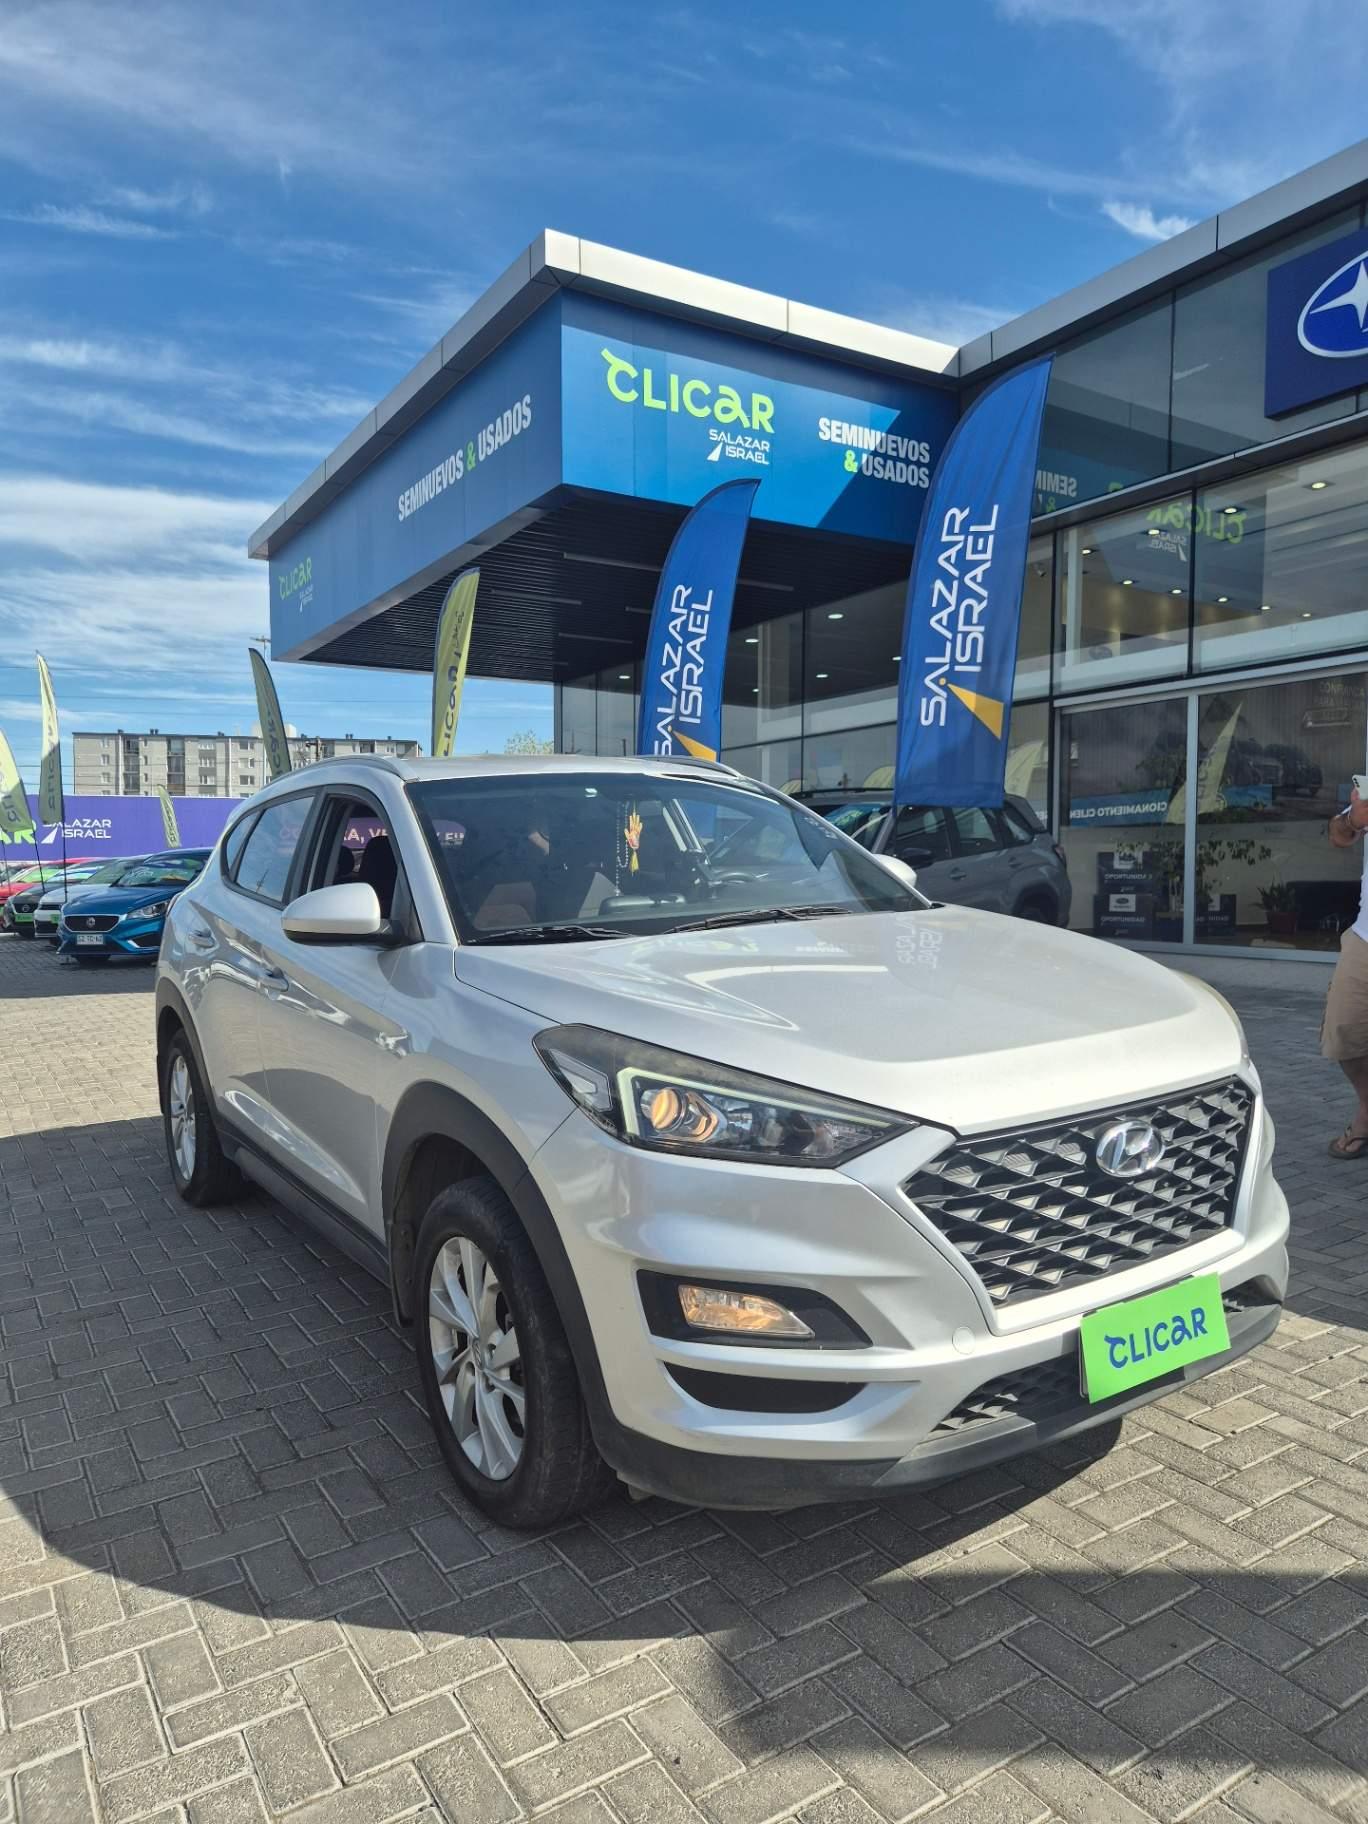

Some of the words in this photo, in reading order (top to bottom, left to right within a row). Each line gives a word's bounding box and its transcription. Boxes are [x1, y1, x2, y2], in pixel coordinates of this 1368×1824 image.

[398, 449, 465, 523] SEMINUEVOS
[466, 441, 477, 472] &
[477, 394, 532, 462] USADOS
[708, 428, 771, 453] SALAZAR
[725, 445, 770, 465] ISRAEL
[818, 417, 930, 464] SEMINUEVOS
[843, 449, 859, 473] &
[861, 453, 930, 489] USADOS
[920, 506, 970, 727] SALAZAR
[954, 504, 999, 673] ISRAEL
[654, 584, 693, 756] SALAZAR
[679, 589, 713, 724] ISRAEL
[61, 829, 112, 839] ISRAEL
